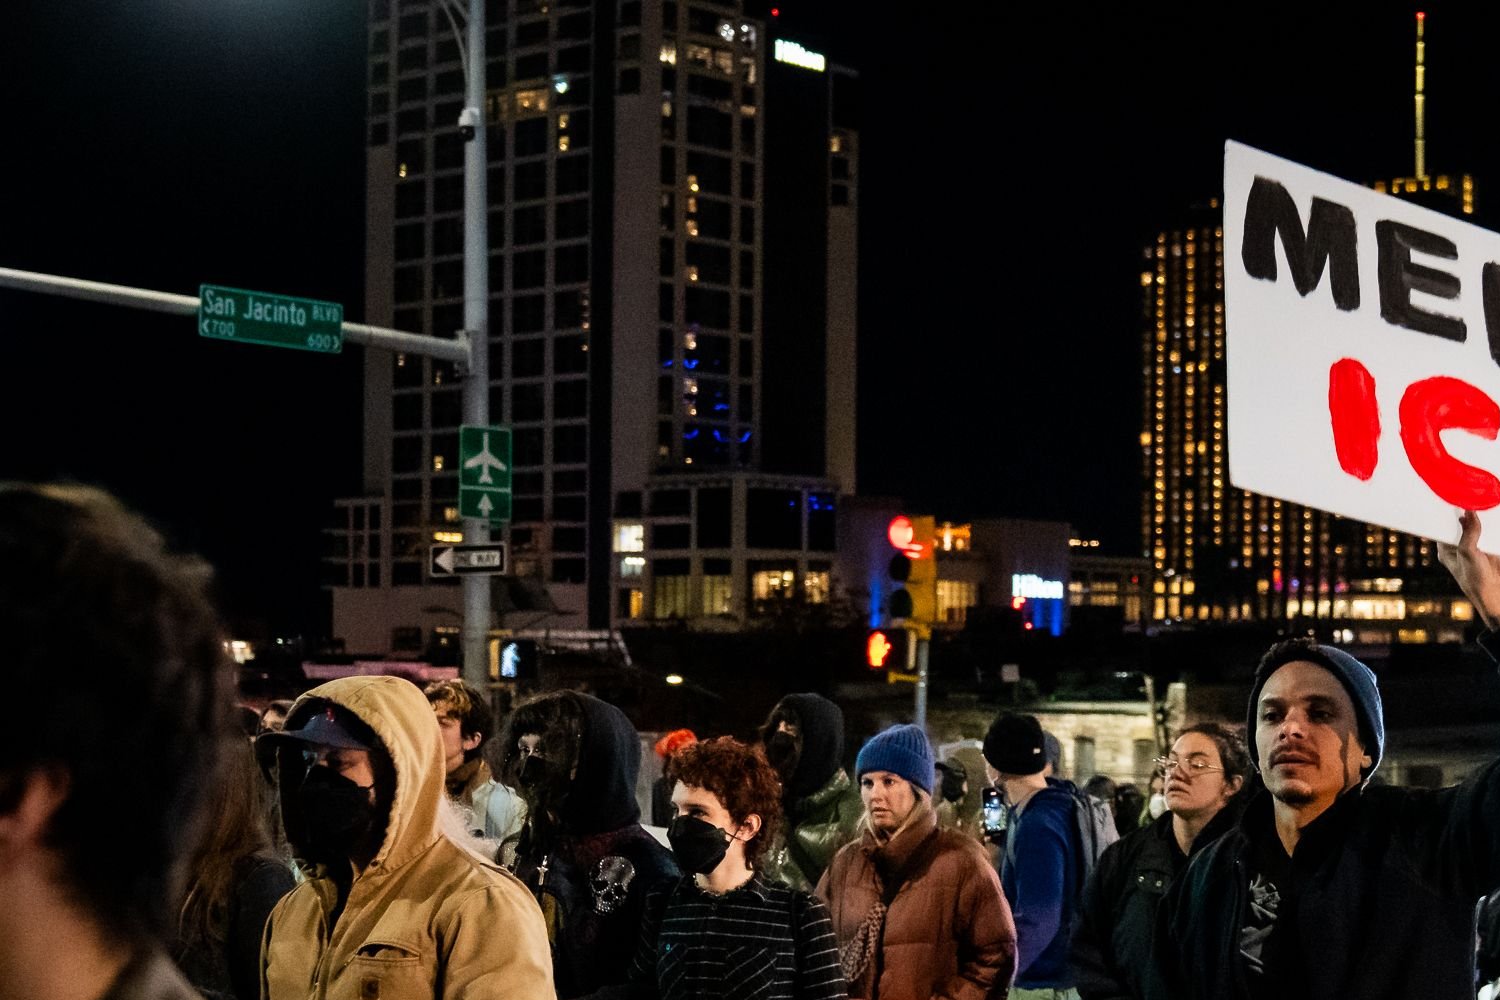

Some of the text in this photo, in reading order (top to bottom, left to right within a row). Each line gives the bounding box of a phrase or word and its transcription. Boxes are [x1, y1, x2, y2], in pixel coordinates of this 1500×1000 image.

[204, 289, 339, 327] San Jacinto BLVD
[212, 319, 235, 337] 700
[307, 332, 331, 349] 600
[1012, 574, 1064, 599] Hilton
